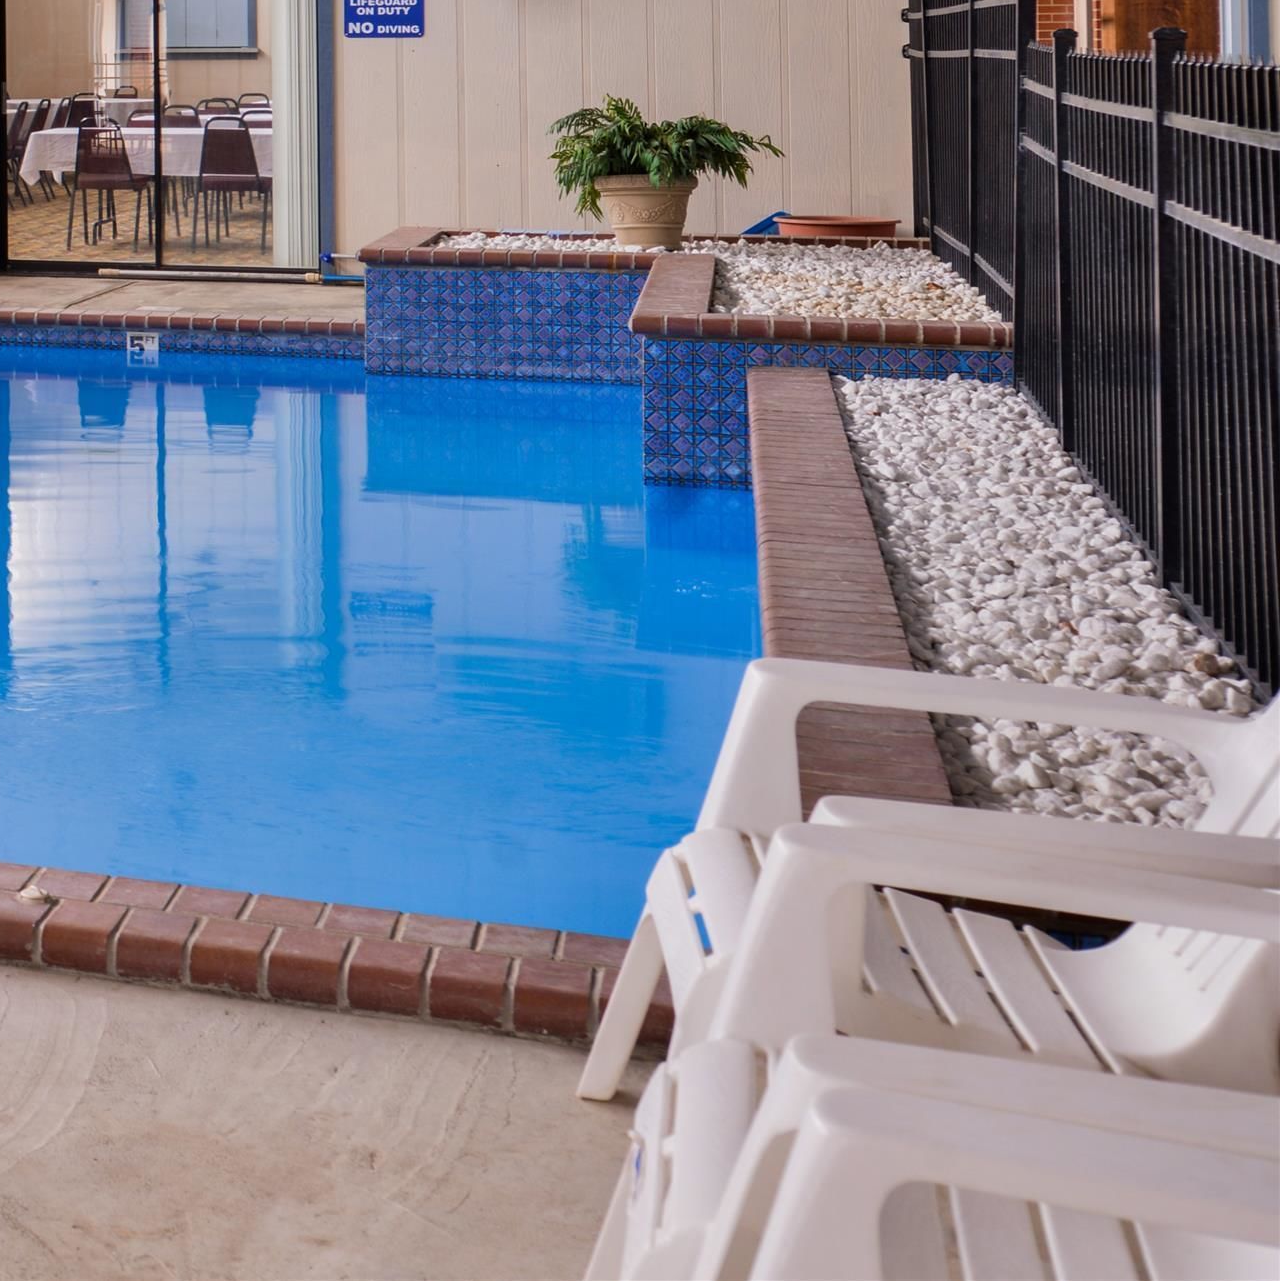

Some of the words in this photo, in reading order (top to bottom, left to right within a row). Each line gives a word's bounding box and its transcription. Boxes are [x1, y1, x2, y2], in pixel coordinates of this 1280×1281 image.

[356, 7, 374, 15] ON
[377, 6, 411, 15] DUTY
[348, 22, 374, 34] NO
[377, 25, 420, 34] DIVING
